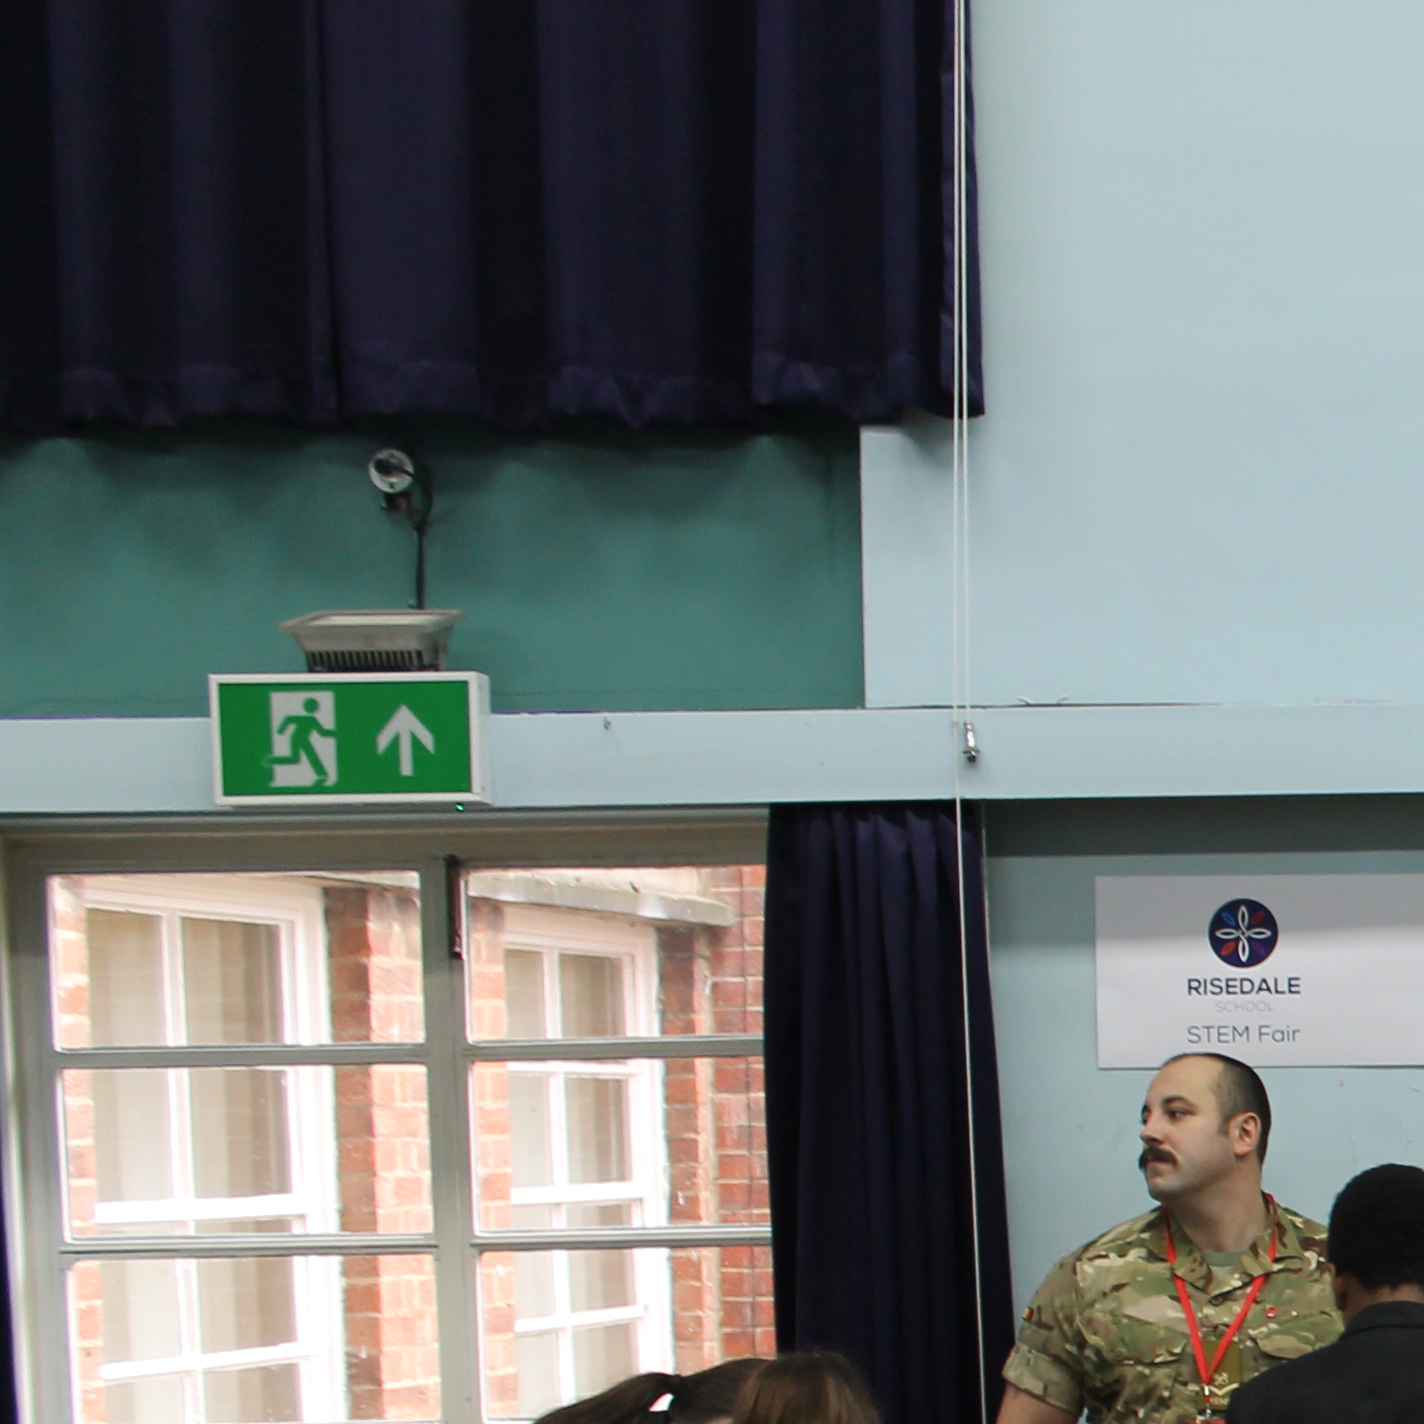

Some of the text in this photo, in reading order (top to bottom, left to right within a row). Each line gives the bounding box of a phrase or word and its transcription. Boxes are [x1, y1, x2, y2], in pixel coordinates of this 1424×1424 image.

[1187, 977, 1300, 995] RISEDALE
[1215, 1000, 1274, 1012] SCHOOL
[1187, 1024, 1300, 1043] STEM Fair
